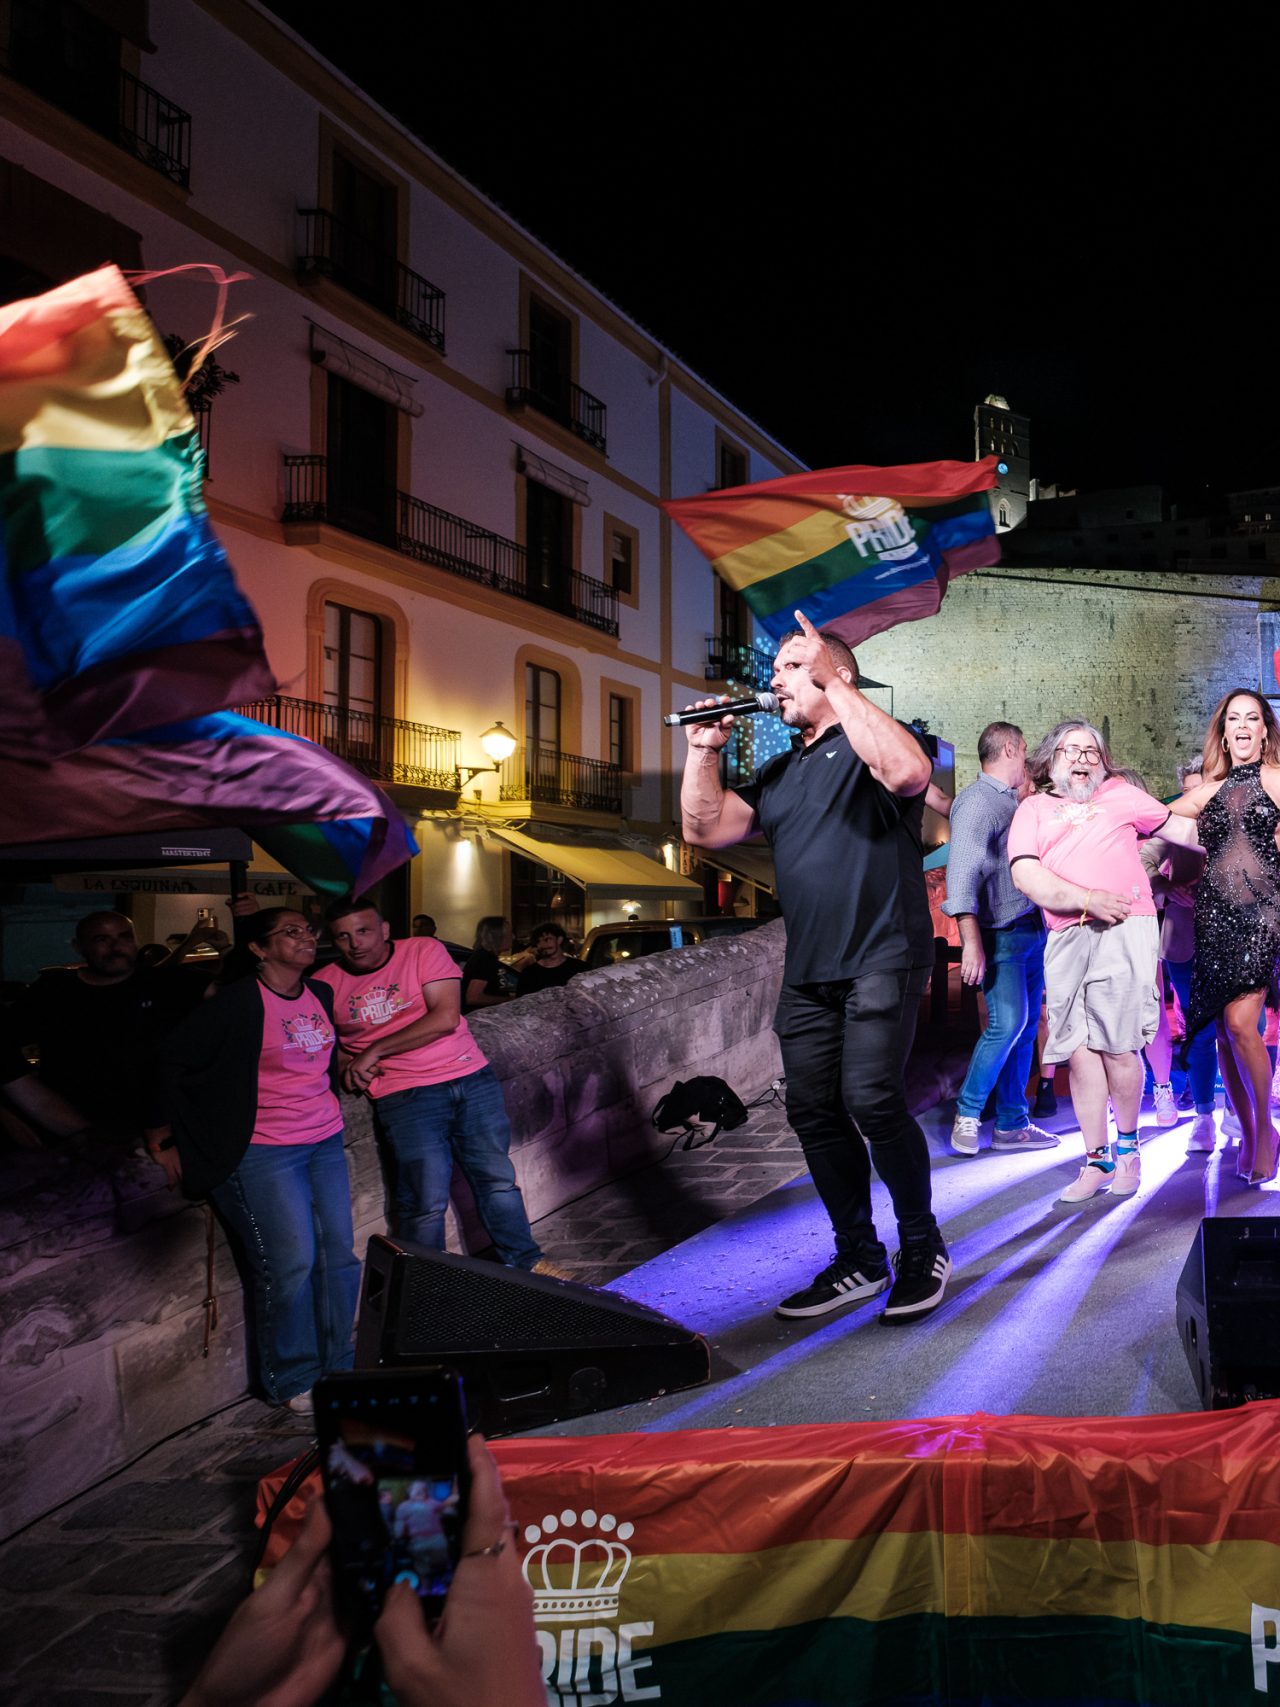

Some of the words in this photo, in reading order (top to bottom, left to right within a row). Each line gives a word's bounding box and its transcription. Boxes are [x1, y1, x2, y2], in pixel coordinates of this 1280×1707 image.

[84, 878, 105, 890] LA
[360, 999, 398, 1022] PRIDE
[294, 1029, 328, 1048] PRIDE
